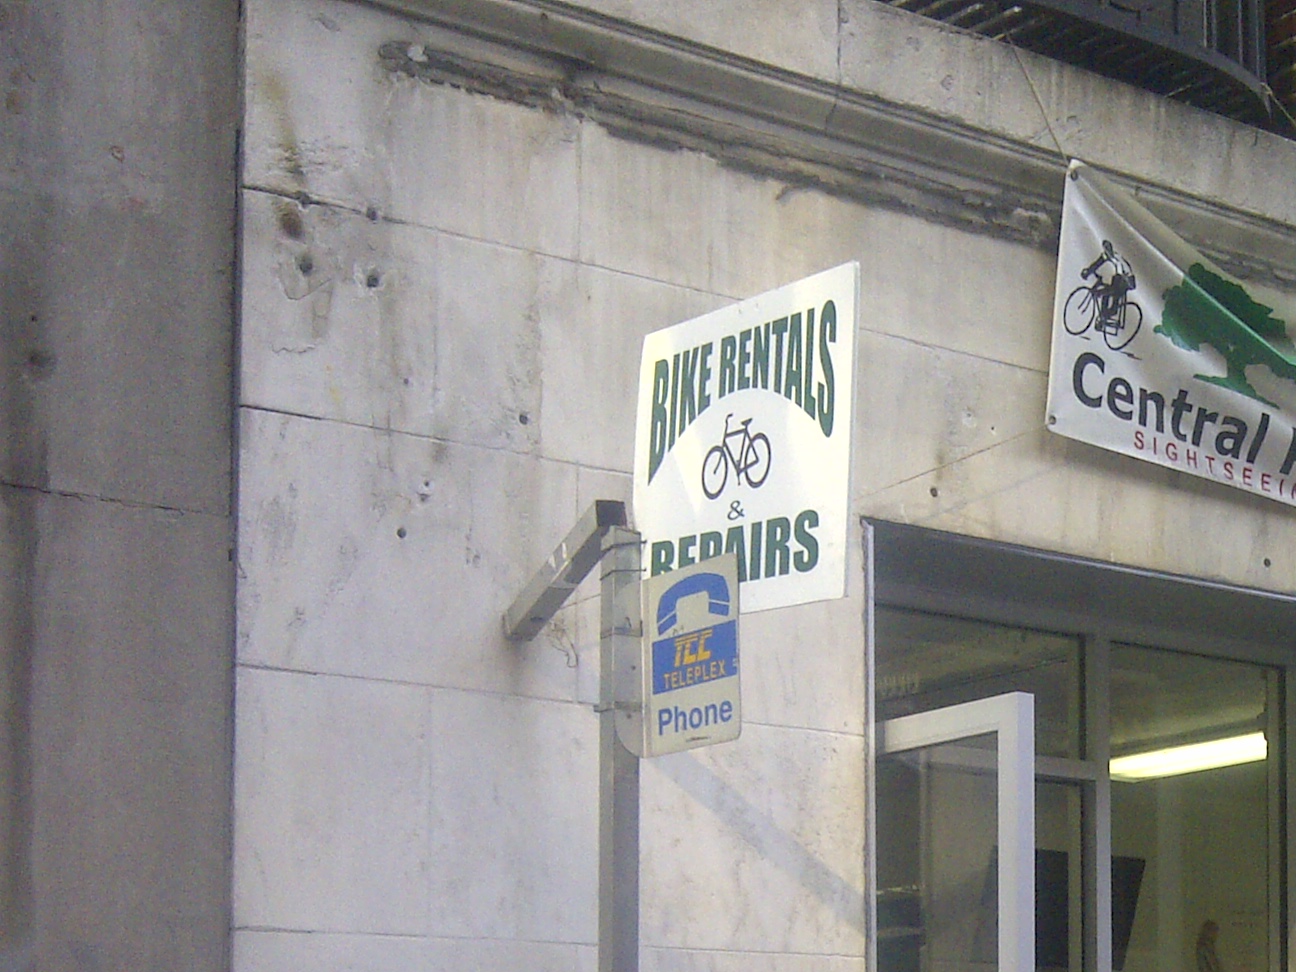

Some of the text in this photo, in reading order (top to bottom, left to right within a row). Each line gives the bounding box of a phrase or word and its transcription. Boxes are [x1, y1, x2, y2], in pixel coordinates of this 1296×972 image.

[648, 300, 837, 486] BIKE RENTALS
[1072, 352, 1271, 464] Central
[727, 500, 745, 521] &
[651, 509, 820, 583] REPAIRS
[663, 660, 726, 689] TELEPLEX
[658, 700, 733, 736] Phone
